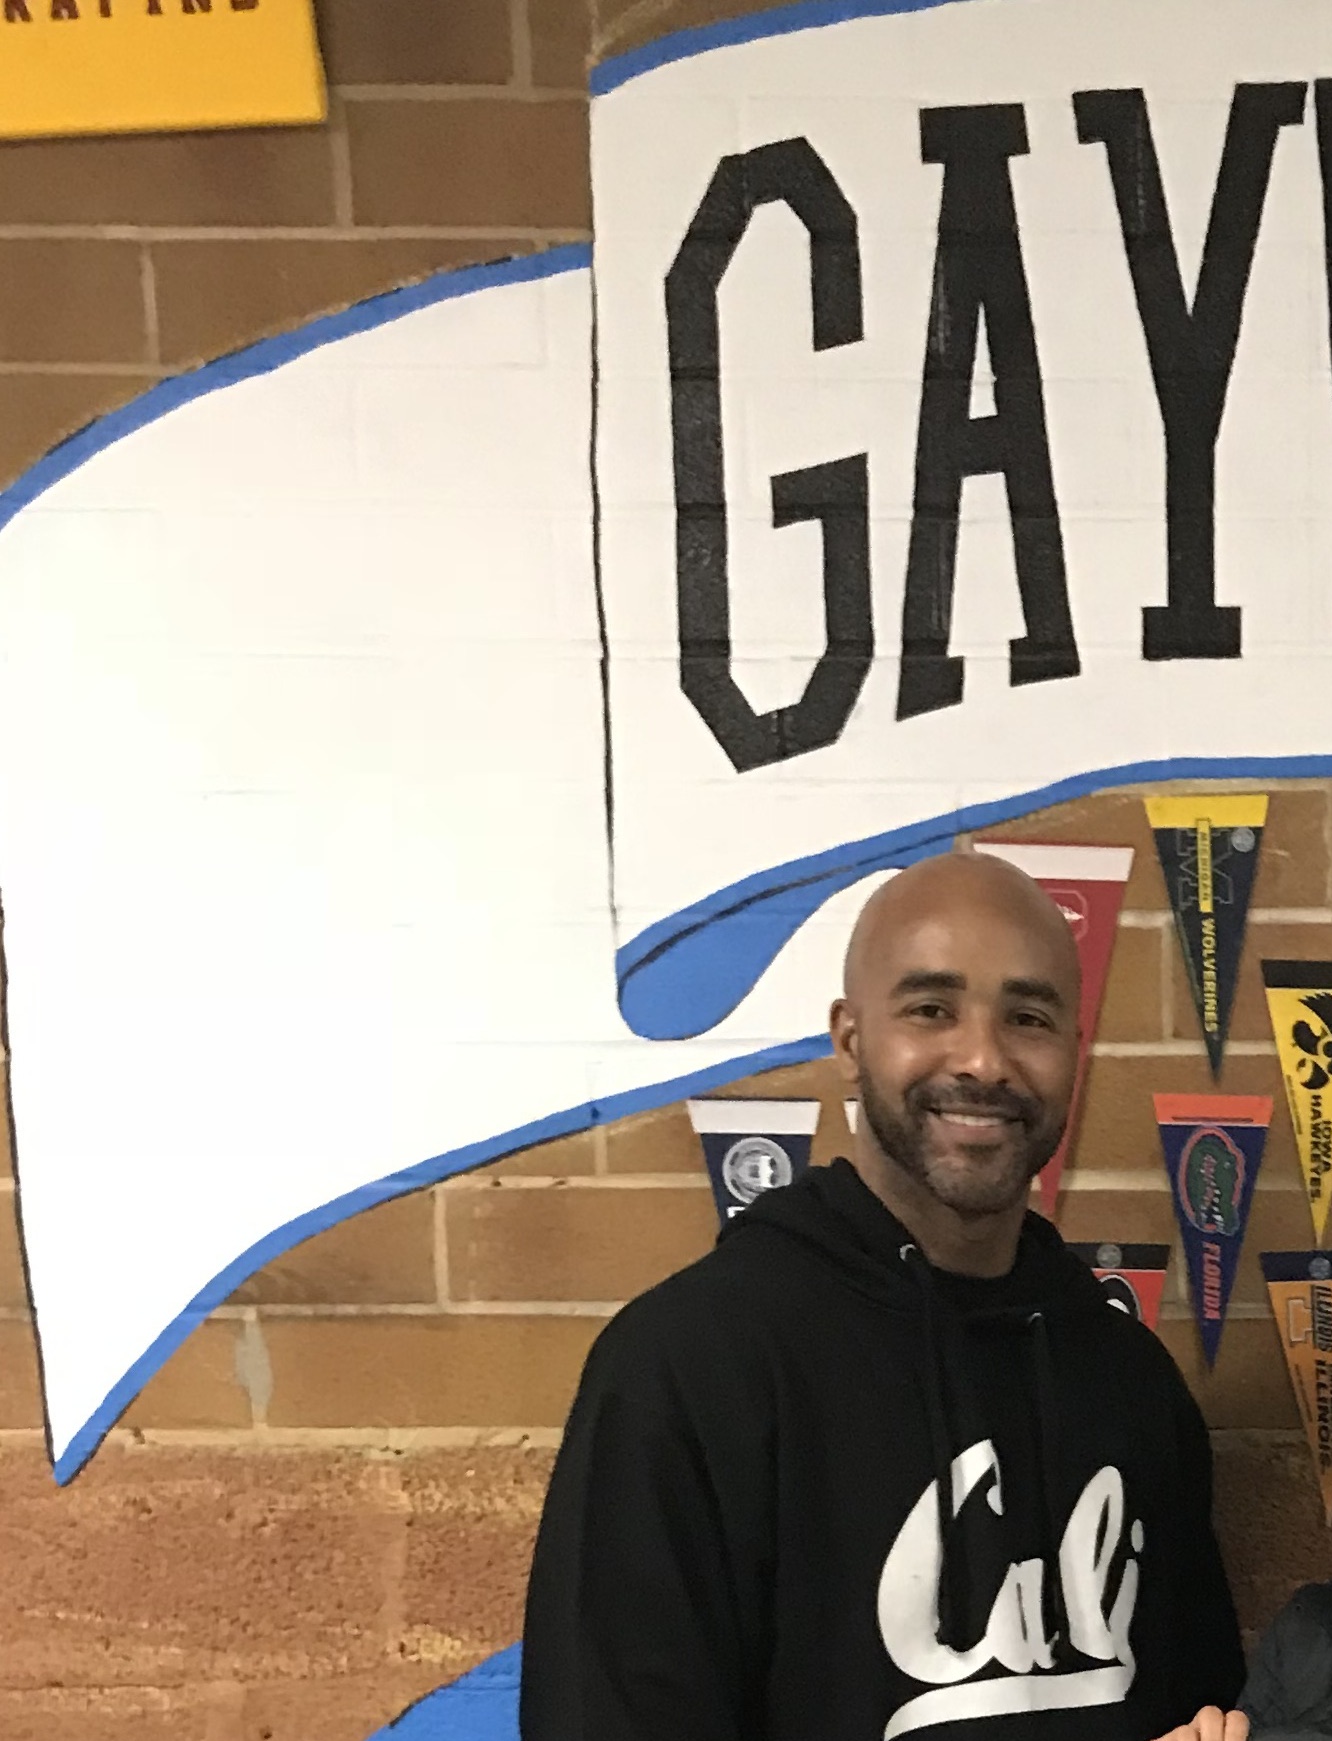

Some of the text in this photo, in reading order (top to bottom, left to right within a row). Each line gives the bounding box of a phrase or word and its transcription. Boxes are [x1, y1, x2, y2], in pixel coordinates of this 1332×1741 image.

[1198, 829, 1211, 903] MICHIGAN
[1201, 917, 1220, 1033] WOLVERINES
[1309, 1094, 1323, 1200] HAWKEYES
[1319, 1120, 1332, 1173] IOWA
[1202, 1240, 1222, 1320] FLORIDA
[1314, 1358, 1332, 1469] ILLINOIS
